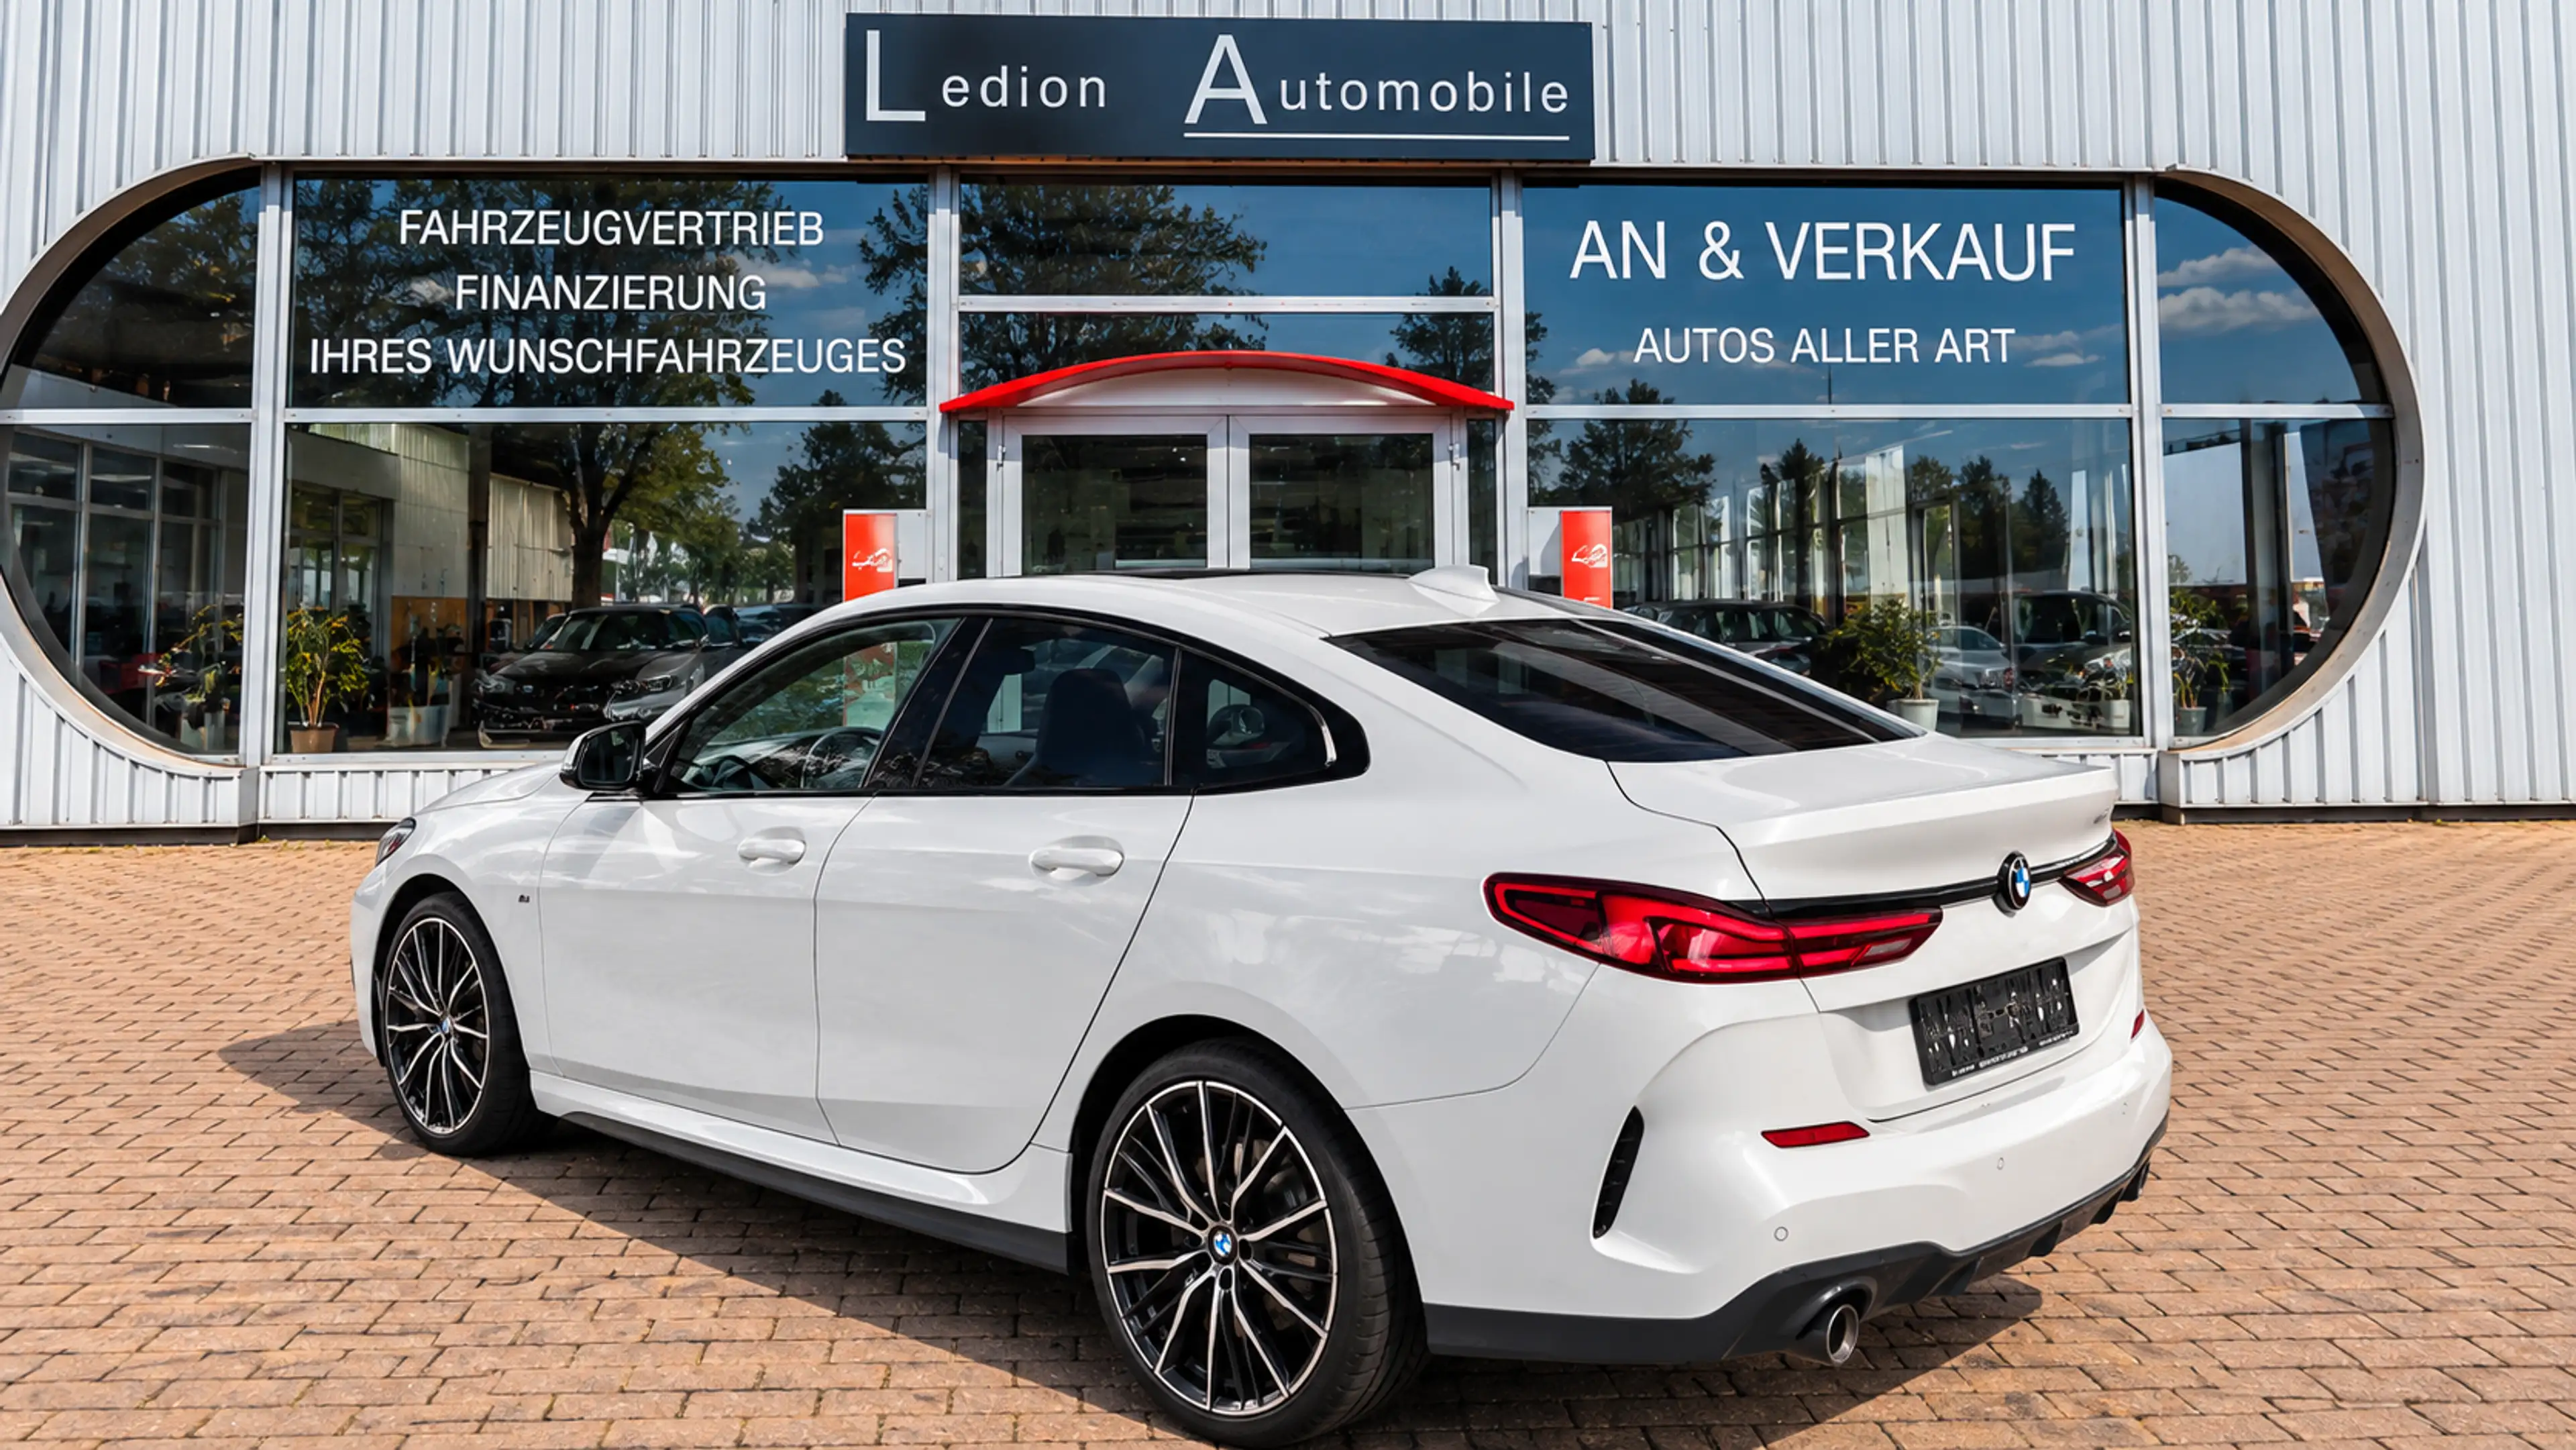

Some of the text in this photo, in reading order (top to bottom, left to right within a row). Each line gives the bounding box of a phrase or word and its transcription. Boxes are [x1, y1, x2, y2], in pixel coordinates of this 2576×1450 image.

[866, 30, 1569, 124] Ledion Automobile
[400, 209, 824, 246] FAHRZEUGVERTRIEB
[1570, 220, 2076, 281] AN & VERKAUF
[456, 274, 766, 310] FINANZIERUNG
[311, 338, 906, 374] IHRES WUNSCHFAHRZEUGES
[1633, 327, 2015, 363] AUTOS ALLER ART
